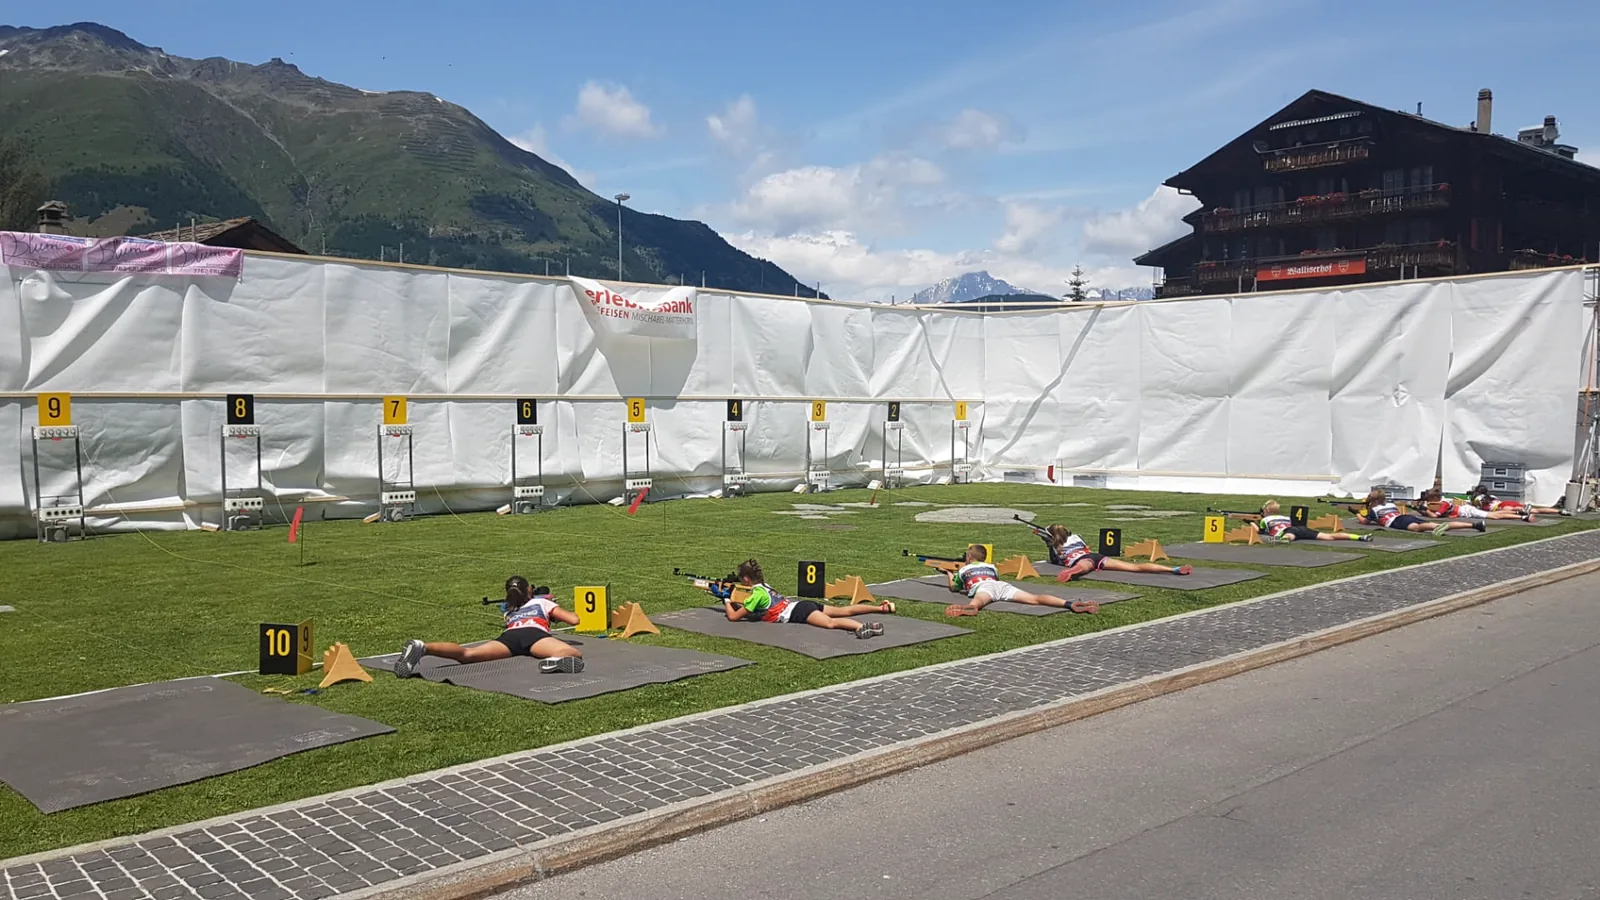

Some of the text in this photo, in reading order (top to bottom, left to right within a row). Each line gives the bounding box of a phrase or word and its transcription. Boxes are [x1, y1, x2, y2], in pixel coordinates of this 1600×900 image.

[1287, 263, 1333, 275] Walliserhof
[48, 397, 61, 419] 9
[235, 399, 246, 417] 8
[391, 401, 400, 417] 7
[522, 402, 531, 418] 6
[632, 401, 640, 417] 5
[731, 402, 739, 416] 4
[815, 403, 823, 417] 3
[891, 404, 898, 417] 2
[1295, 508, 1303, 520] 4
[1211, 519, 1218, 532] 5
[1106, 531, 1114, 546] 6
[806, 565, 816, 583] 8
[585, 592, 596, 613] 9
[265, 629, 290, 656] 10
[303, 626, 309, 652] 9
